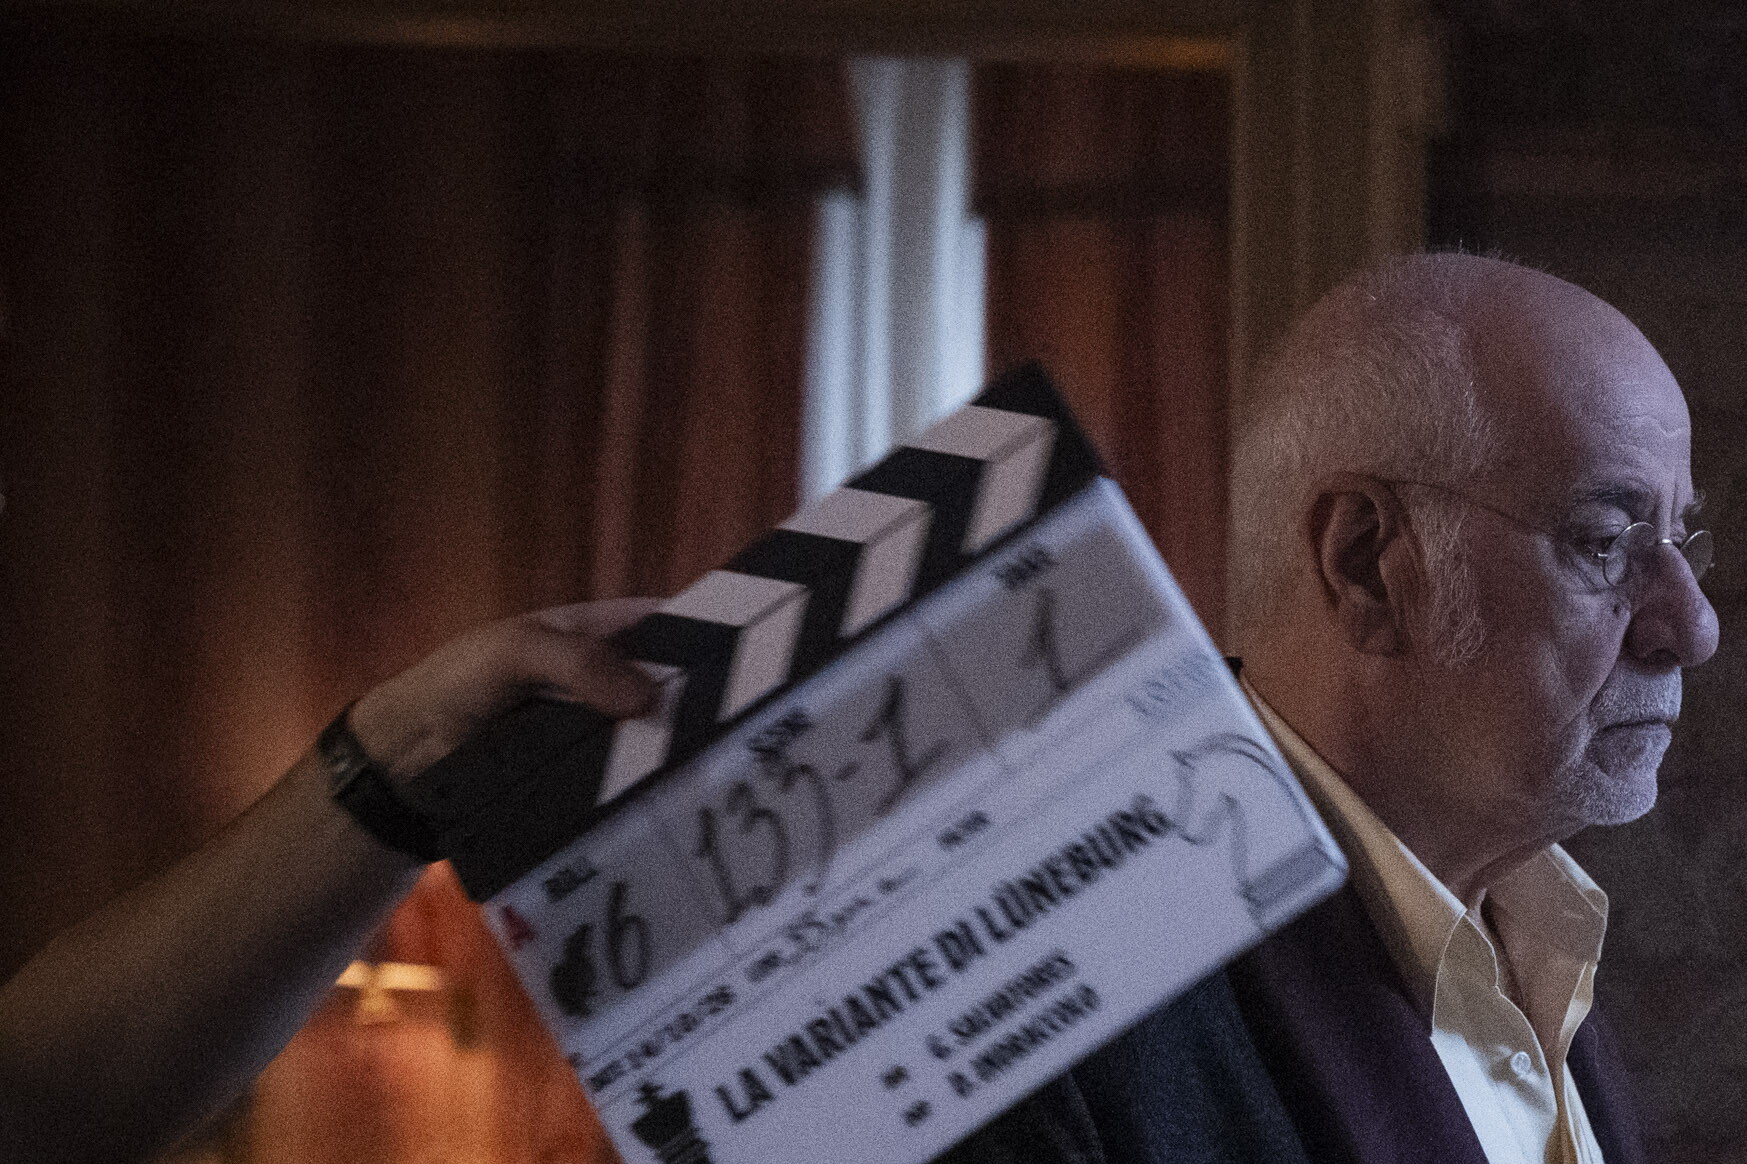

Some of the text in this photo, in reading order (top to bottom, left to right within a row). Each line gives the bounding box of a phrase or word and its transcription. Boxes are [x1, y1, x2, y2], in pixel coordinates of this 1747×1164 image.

[715, 806, 1174, 1123] LA VARIANTE DI LÜNEBURG
